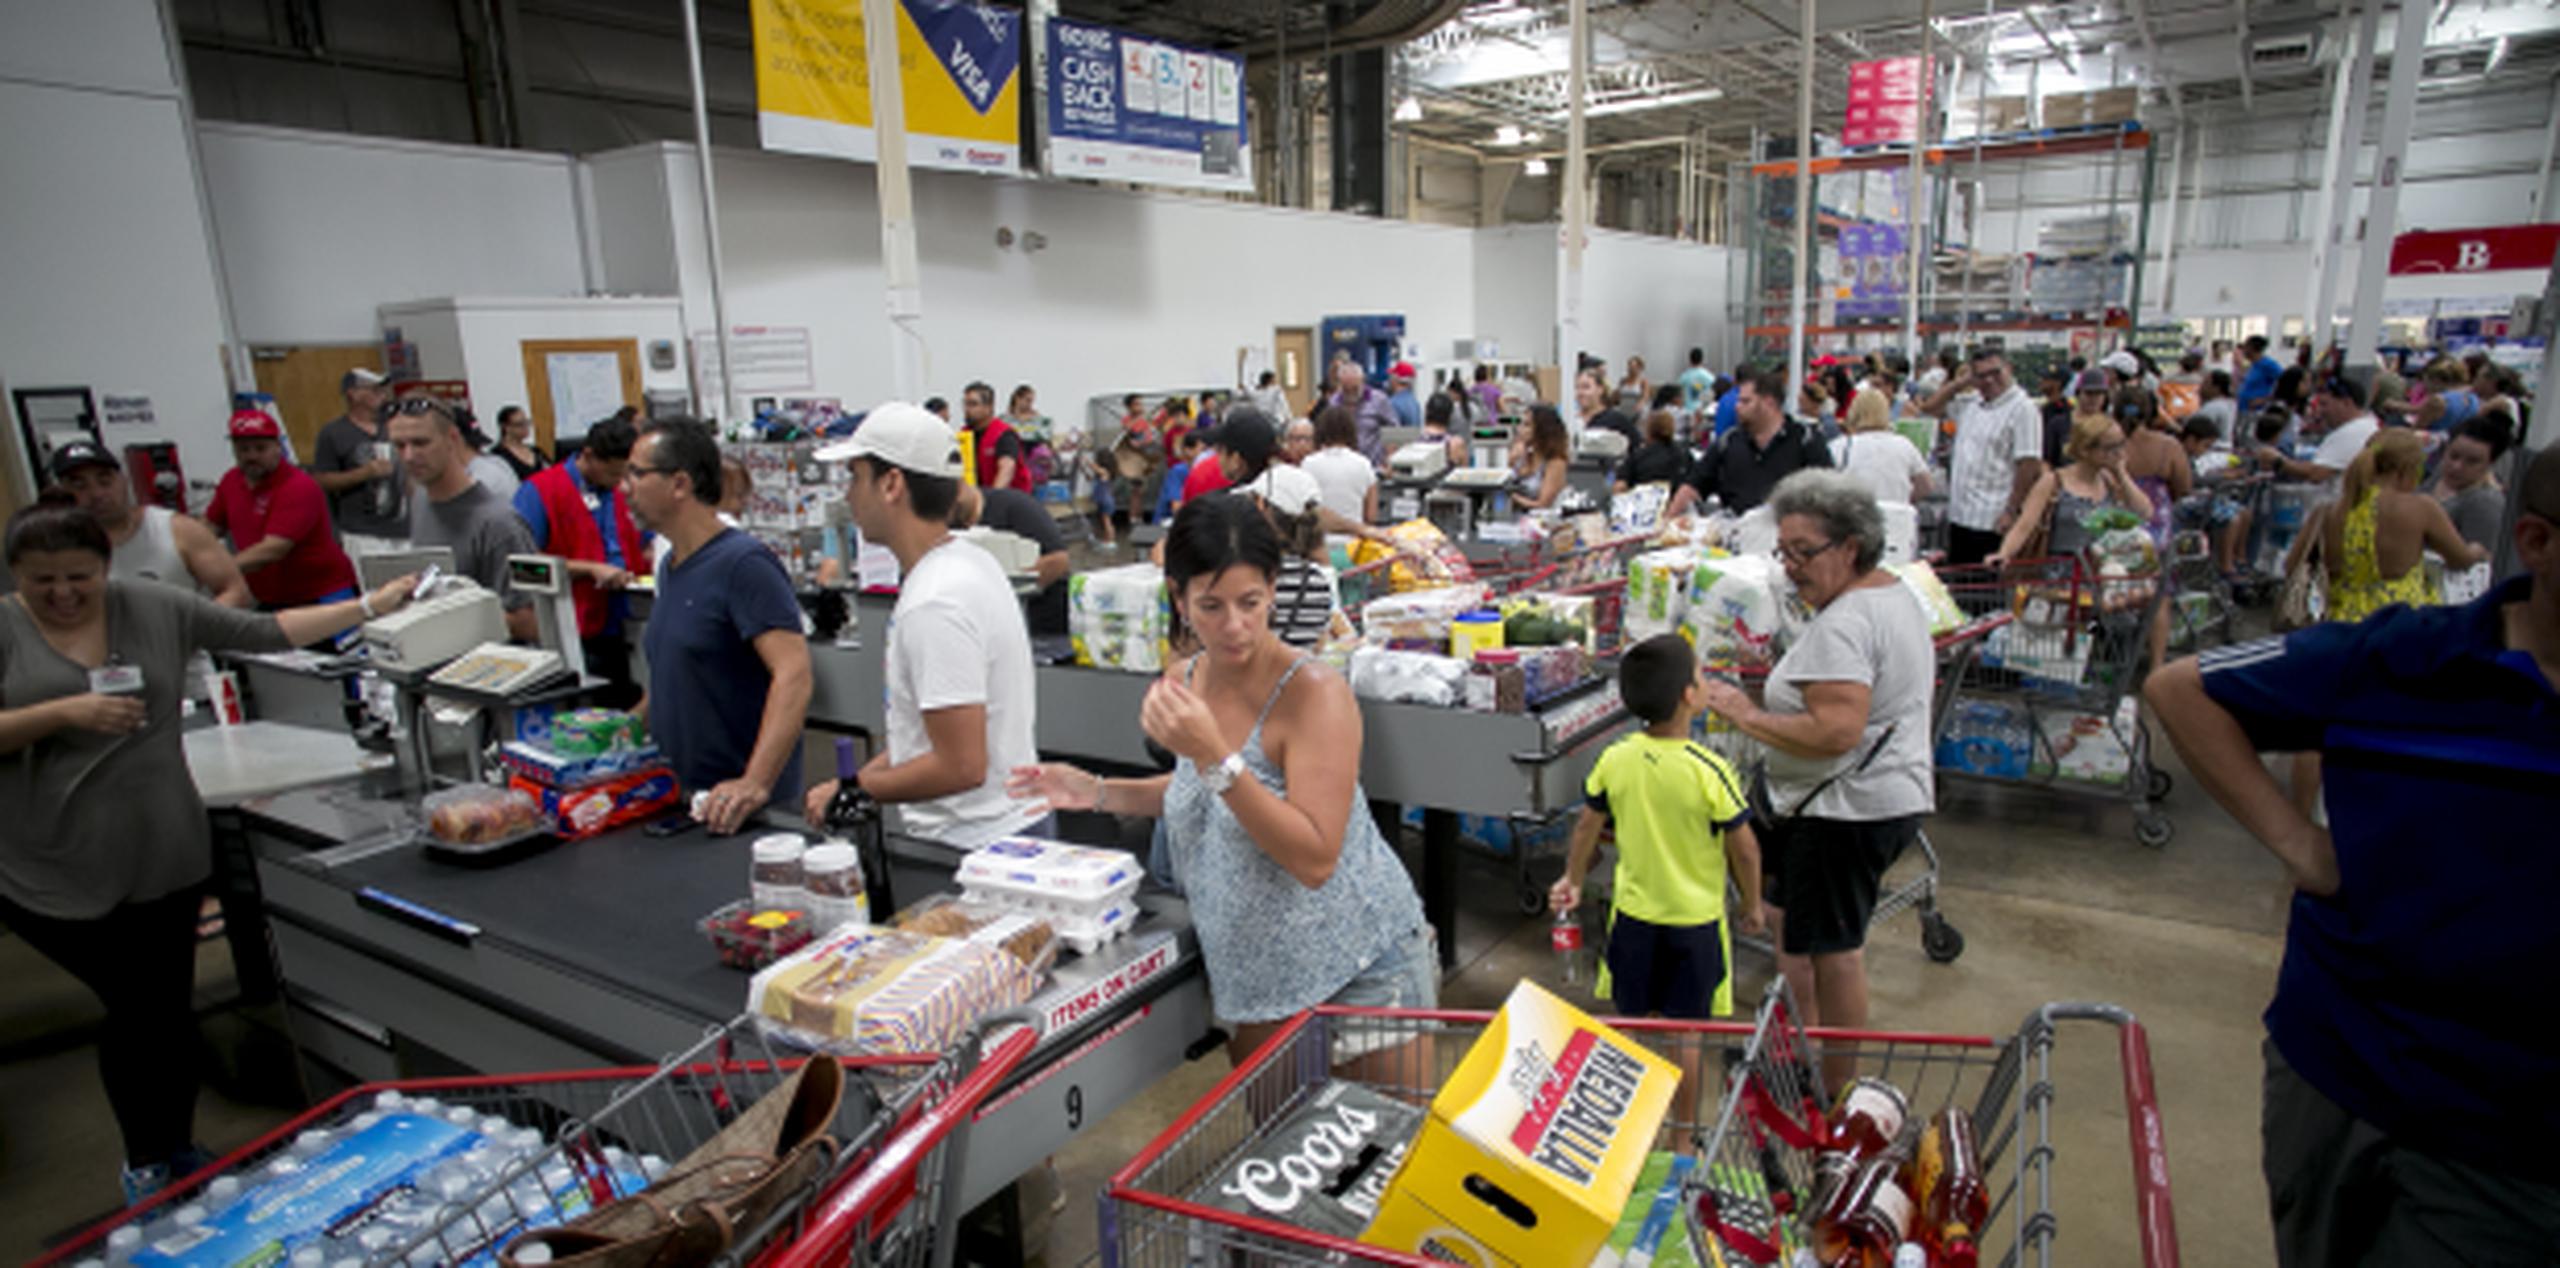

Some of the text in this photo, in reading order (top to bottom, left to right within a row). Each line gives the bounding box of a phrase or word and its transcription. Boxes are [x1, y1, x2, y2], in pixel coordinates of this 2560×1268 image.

[951, 37, 993, 103] VISA
[1061, 56, 1115, 88] CASH
[1062, 82, 1116, 113] BACK
[1051, 948, 1166, 1030] ITEMS ON CART
[1066, 1084, 1083, 1131] 9
[1534, 1038, 1648, 1187] MEDALLA
[1221, 1102, 1377, 1213] Coors
